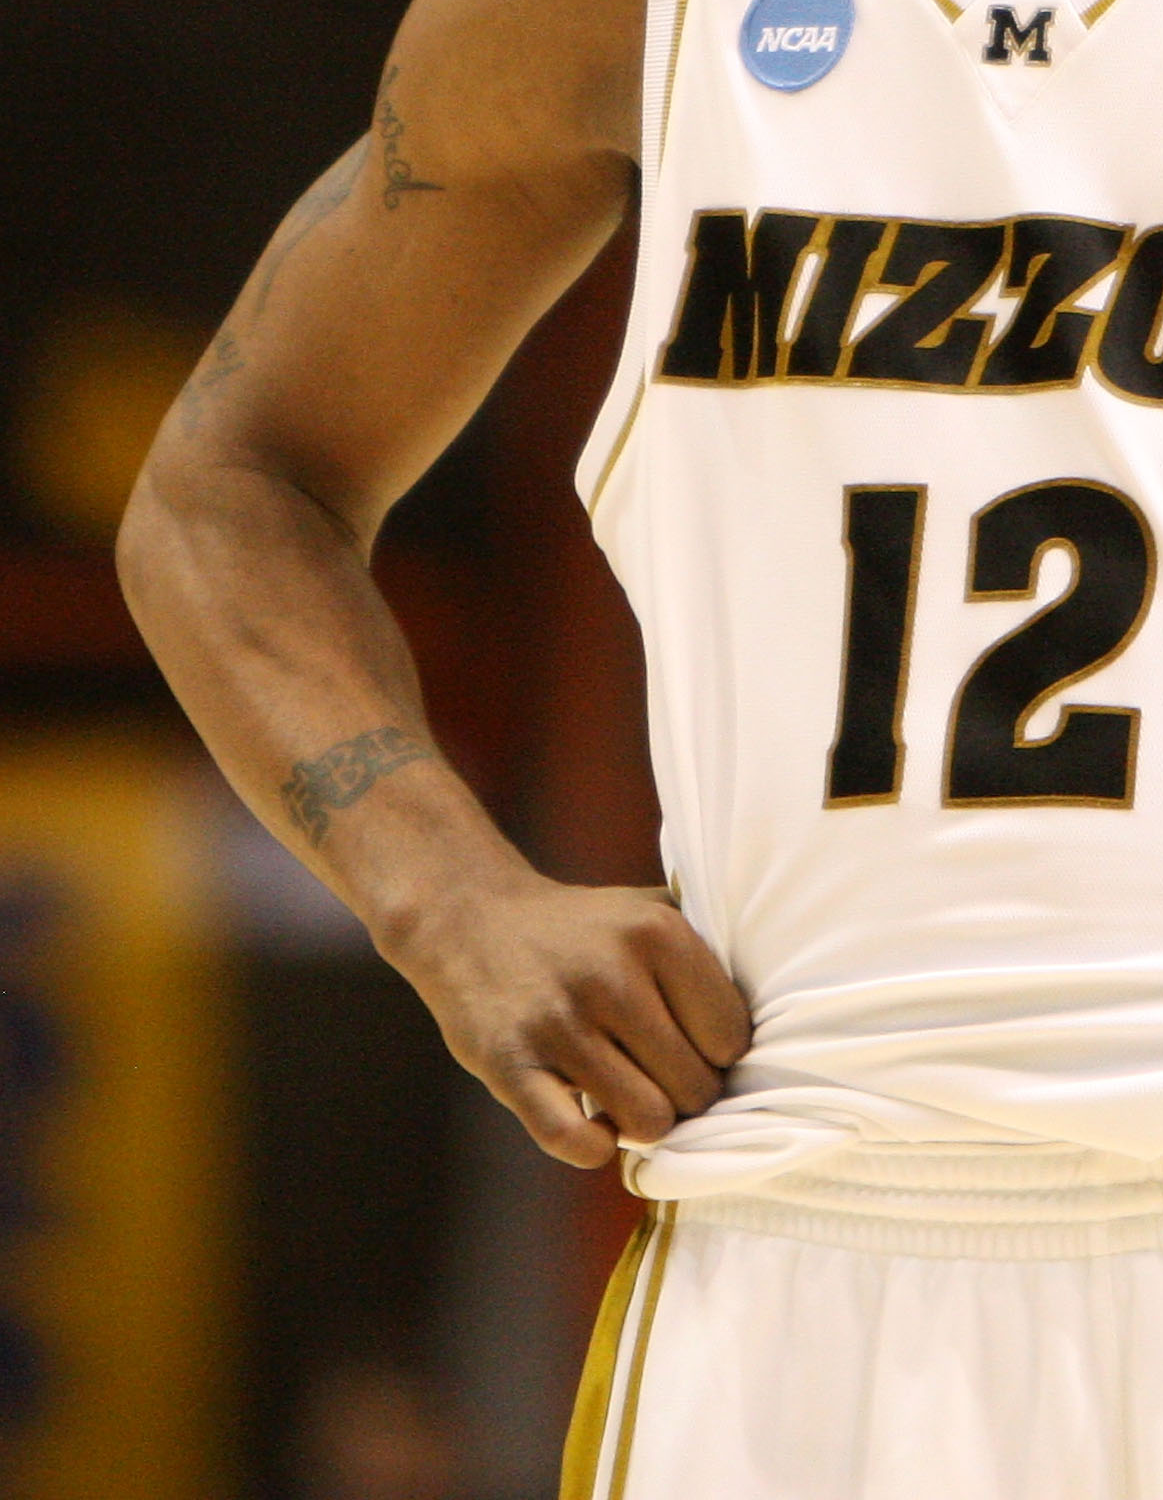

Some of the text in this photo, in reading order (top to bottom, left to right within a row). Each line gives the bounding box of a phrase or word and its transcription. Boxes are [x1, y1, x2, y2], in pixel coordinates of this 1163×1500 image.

[755, 23, 838, 54] NCAA
[981, 5, 1054, 66] M
[823, 477, 1159, 811] 12
